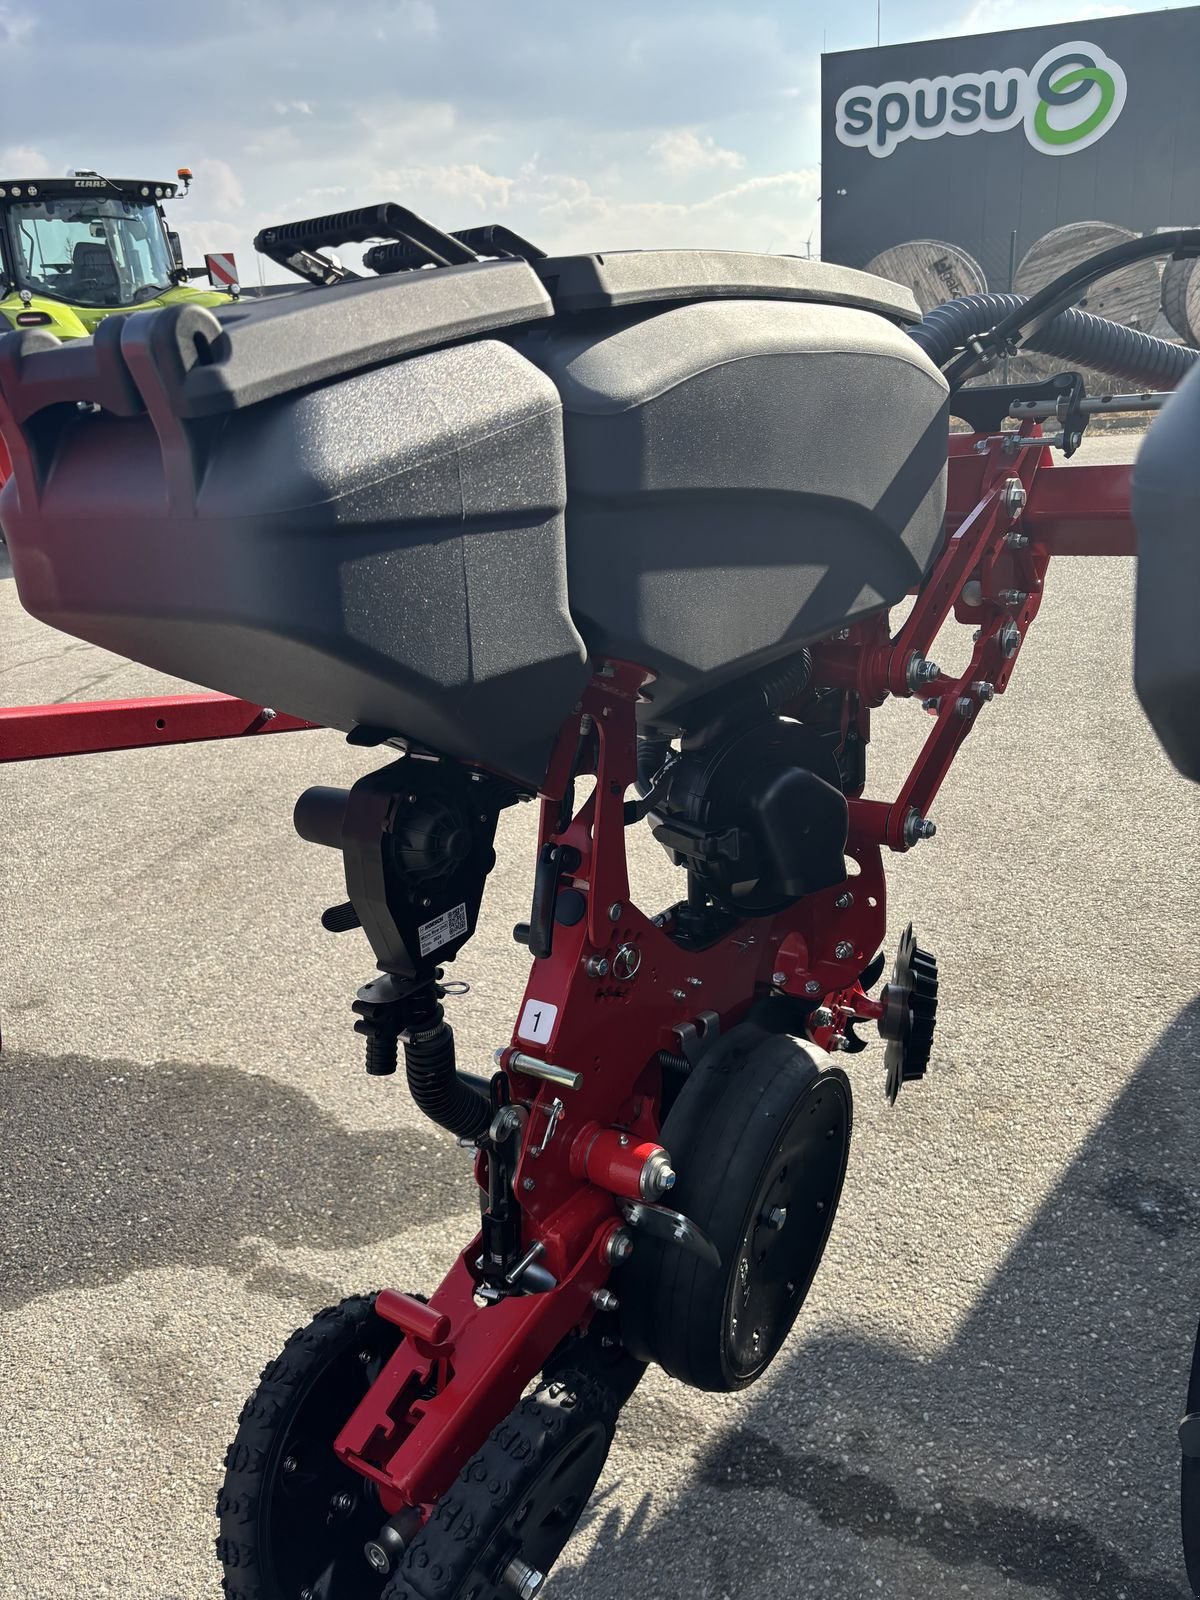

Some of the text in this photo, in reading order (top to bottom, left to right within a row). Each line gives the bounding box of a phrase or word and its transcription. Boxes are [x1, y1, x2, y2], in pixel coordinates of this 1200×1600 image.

[844, 78, 1018, 146] spusu
[74, 180, 107, 188] CLAAS
[533, 1011, 542, 1033] 1
